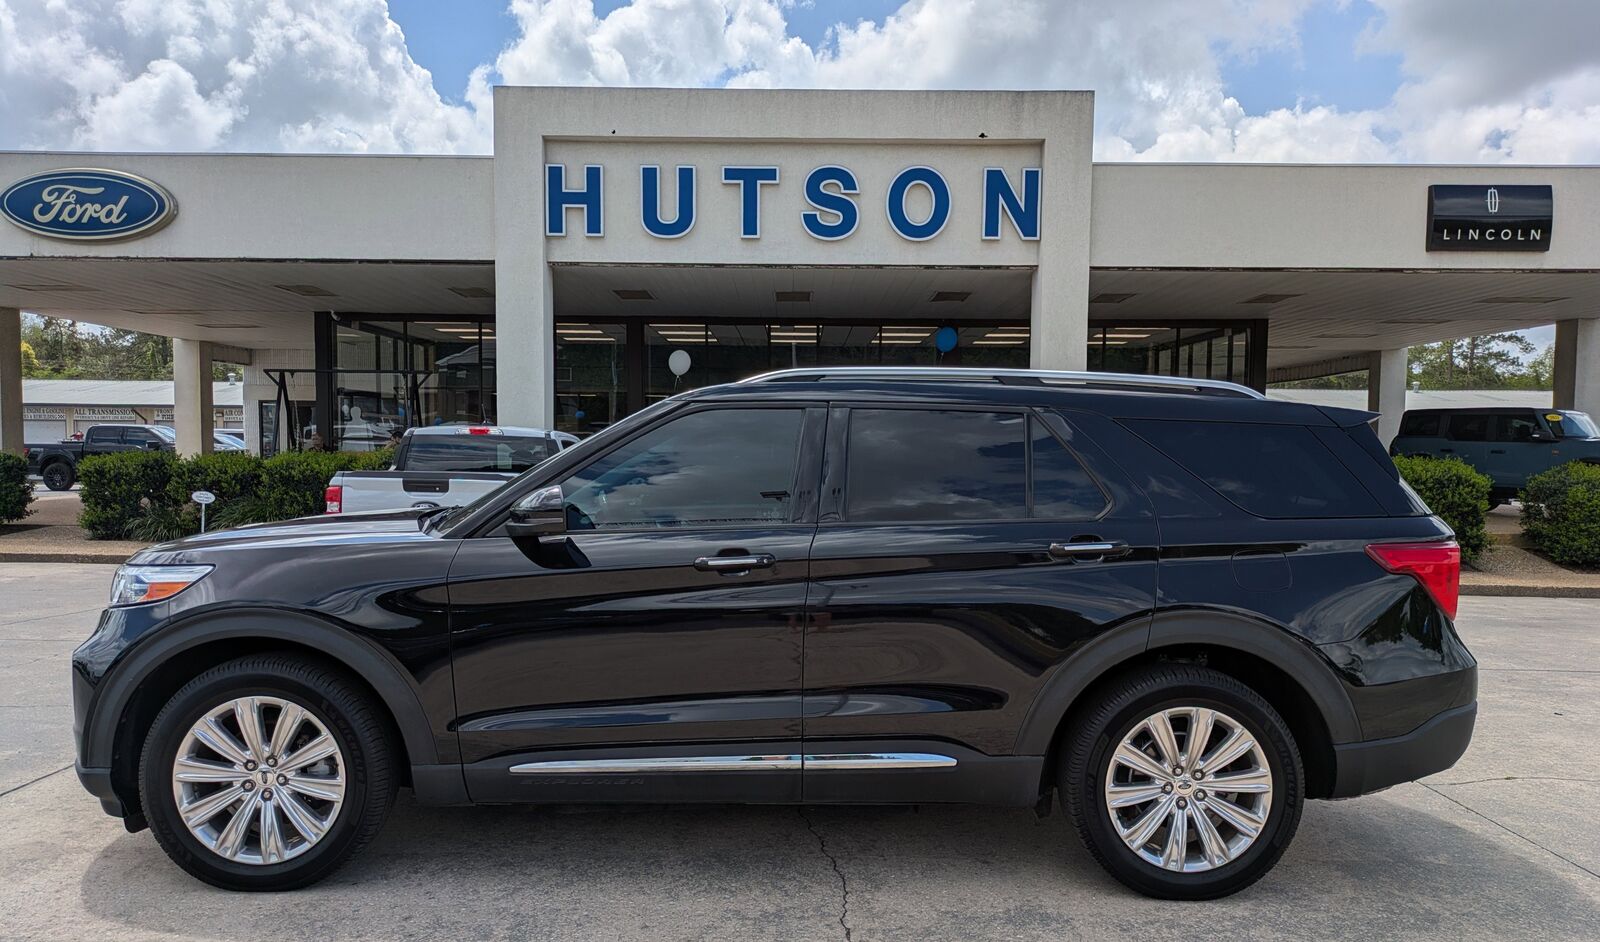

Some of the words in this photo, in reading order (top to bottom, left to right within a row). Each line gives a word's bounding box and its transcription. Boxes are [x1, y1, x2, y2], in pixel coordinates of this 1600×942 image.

[33, 184, 129, 224] Ford
[545, 164, 1043, 242] HUTSON
[1443, 229, 1541, 240] LINCOLN
